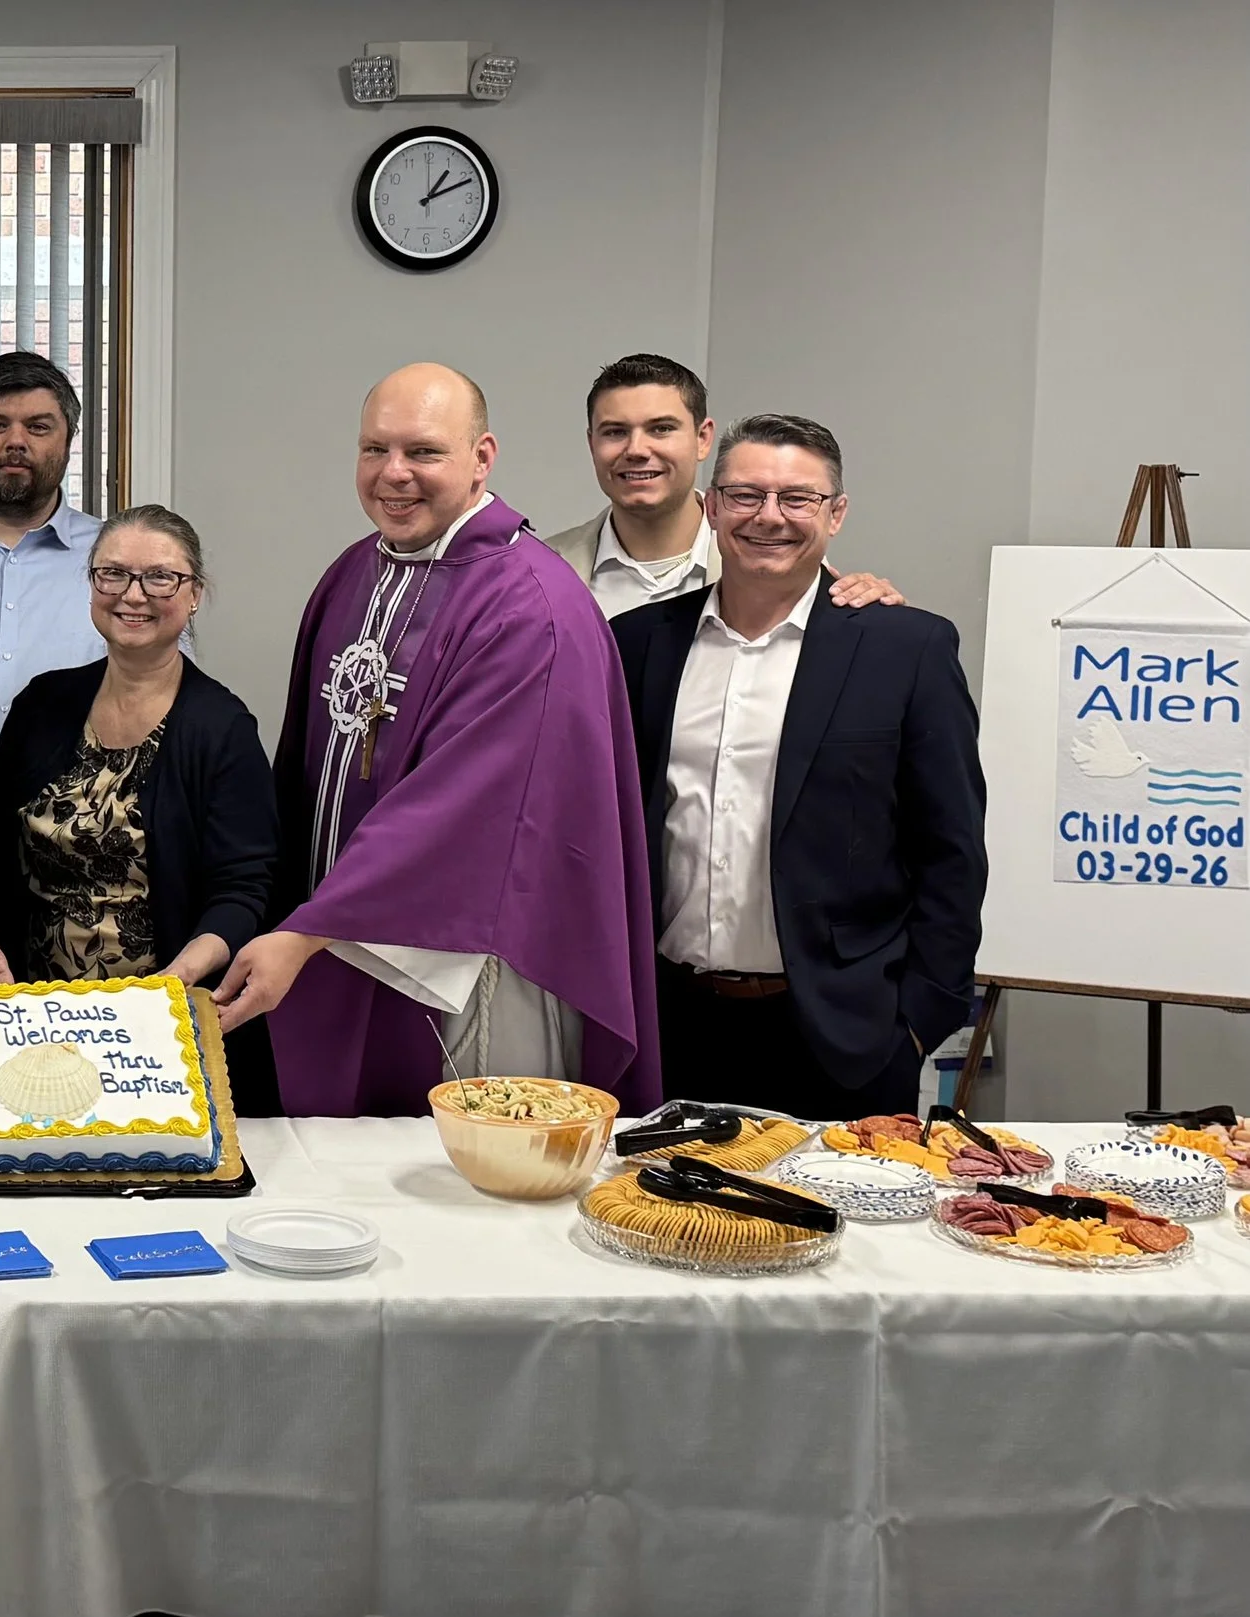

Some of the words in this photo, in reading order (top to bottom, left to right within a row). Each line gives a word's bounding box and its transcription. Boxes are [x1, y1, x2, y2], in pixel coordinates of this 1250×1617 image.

[404, 158, 414, 169] 11
[423, 152, 434, 164] 12
[390, 173, 400, 185] 10
[382, 193, 389, 205] 9
[465, 192, 473, 204] 3
[388, 213, 395, 225] 8
[458, 213, 465, 224] 4
[404, 228, 410, 239] 7
[422, 233, 430, 245] 6
[443, 228, 450, 240] 5
[1073, 645, 1240, 686] Mark
[1077, 685, 1240, 722] Allen
[1060, 811, 1139, 845] Child
[1147, 815, 1178, 845] of
[1184, 816, 1244, 848] God
[1077, 850, 1229, 886] 03-29-26
[44, 1001, 118, 1023] Pauls
[4, 1026, 132, 1046] Welcomes
[102, 1050, 163, 1069] thru
[100, 1072, 189, 1099] Baptism
